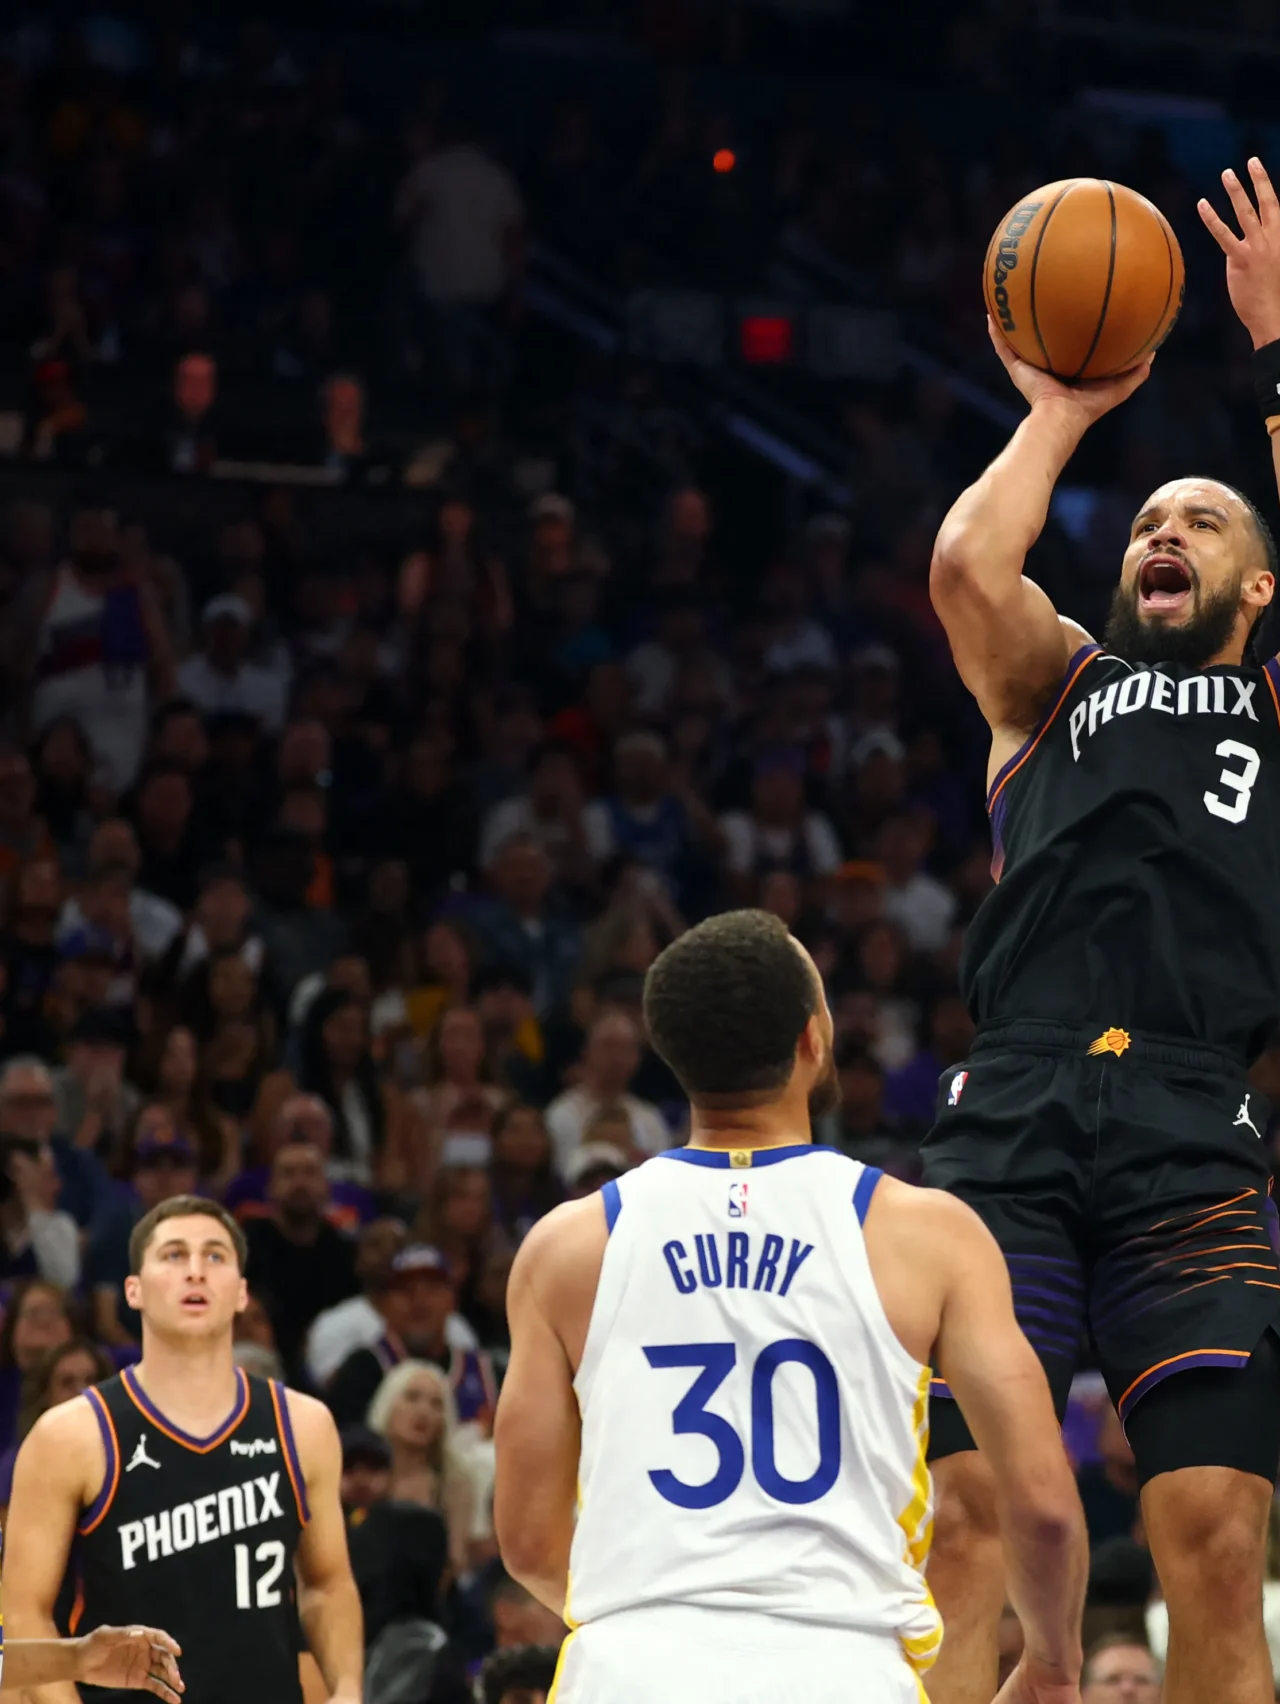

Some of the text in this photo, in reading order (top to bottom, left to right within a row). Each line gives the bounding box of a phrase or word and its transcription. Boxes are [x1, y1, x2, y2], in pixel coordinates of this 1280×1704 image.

[994, 202, 1044, 332] Wilson
[1069, 670, 1260, 763] PHOENIX
[1203, 738, 1261, 824] 3
[662, 1231, 815, 1297] CURRY
[230, 1438, 277, 1458] PayPal
[641, 1338, 841, 1509] 30
[117, 1471, 284, 1570] PHOENIX
[234, 1540, 285, 1609] 12
